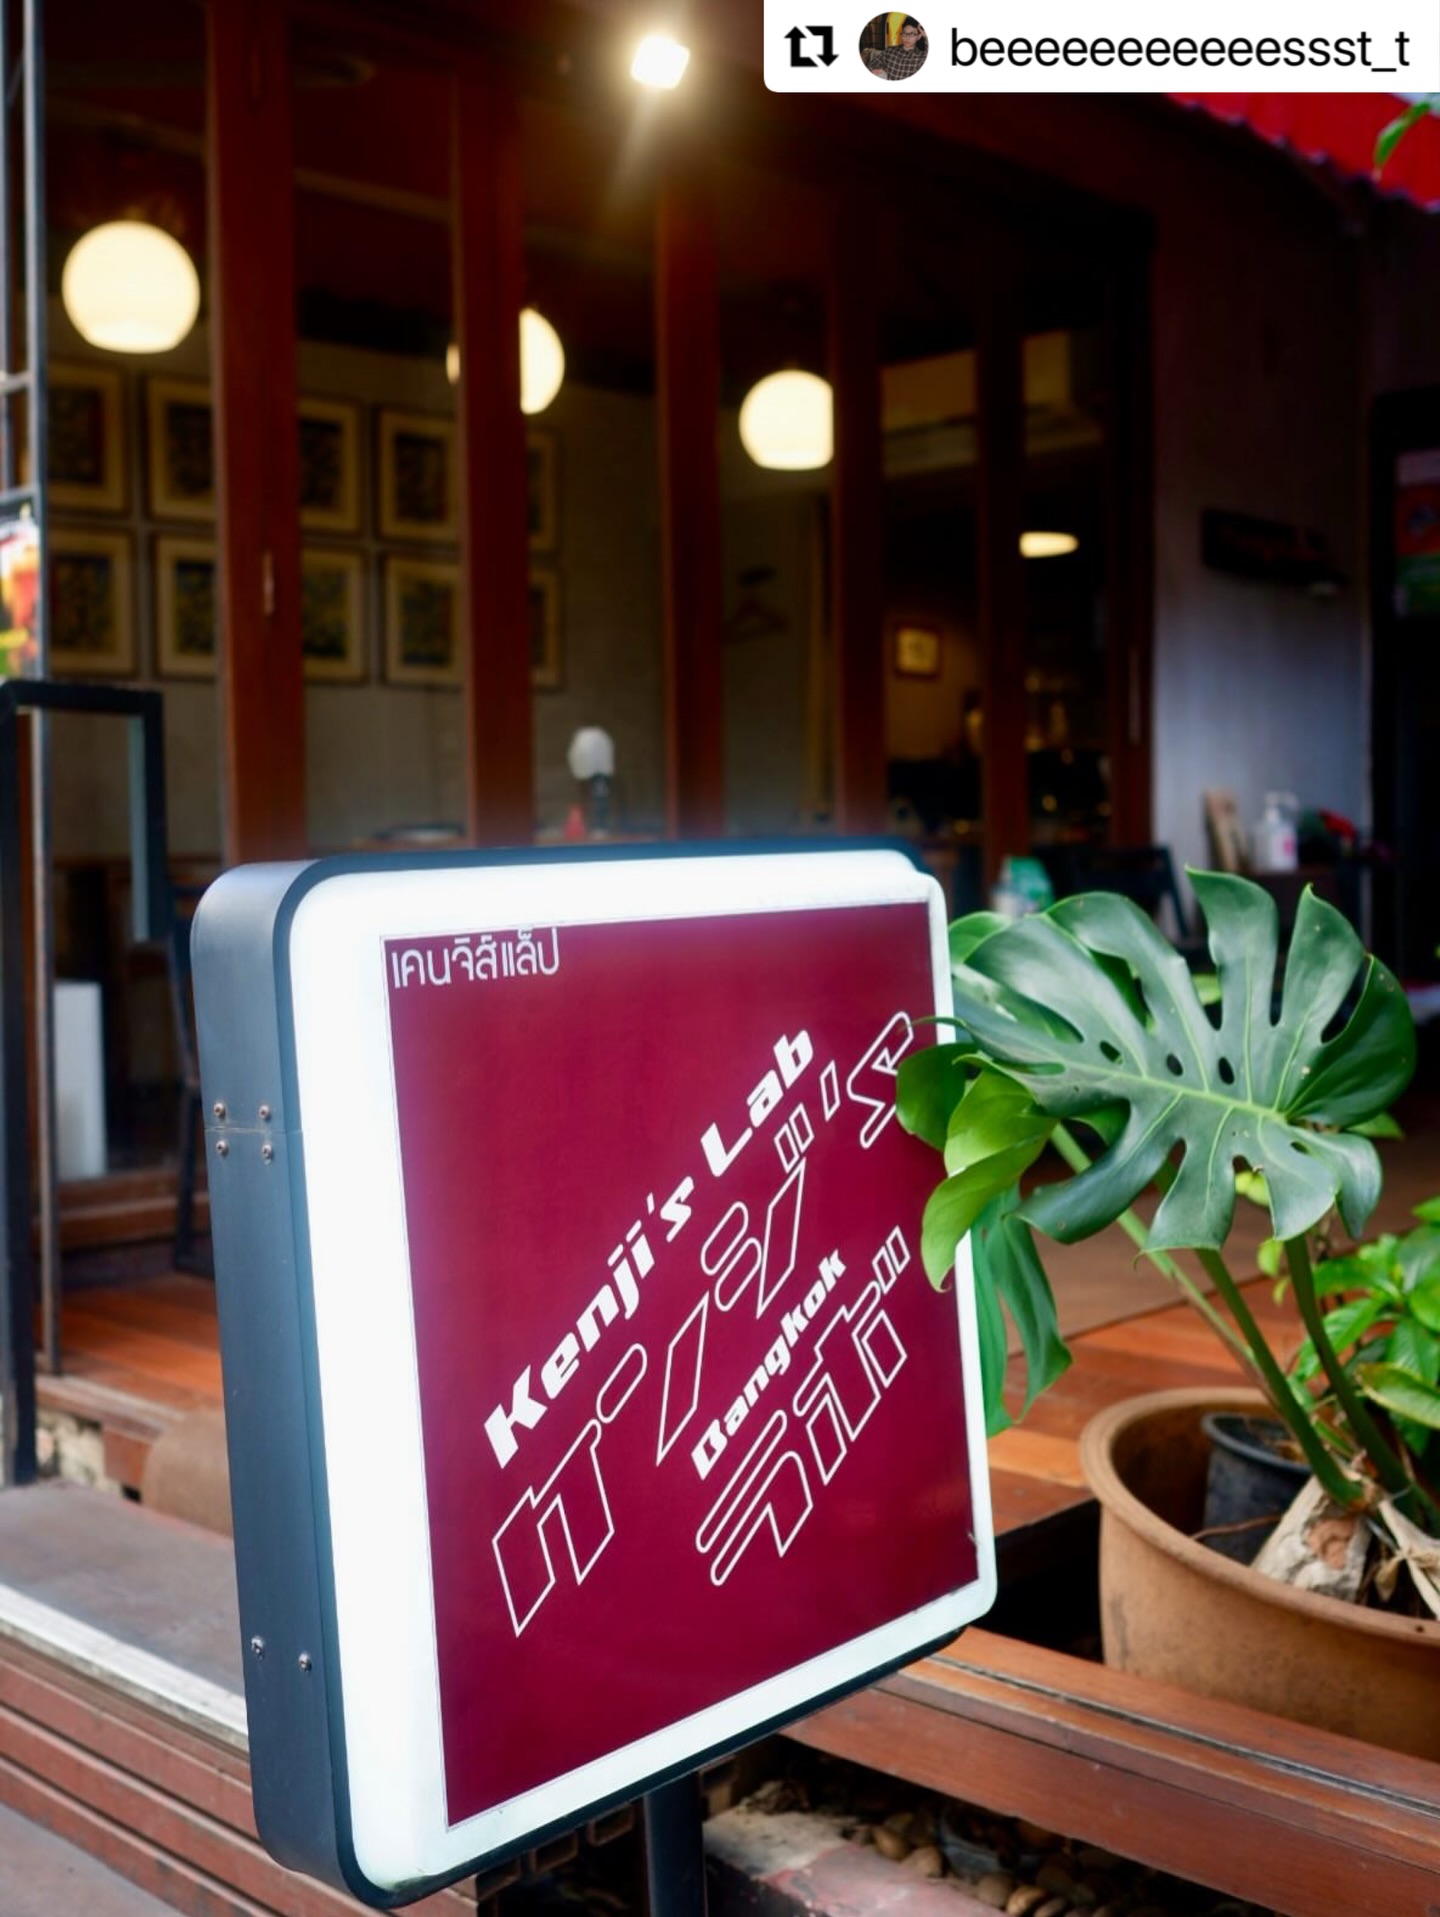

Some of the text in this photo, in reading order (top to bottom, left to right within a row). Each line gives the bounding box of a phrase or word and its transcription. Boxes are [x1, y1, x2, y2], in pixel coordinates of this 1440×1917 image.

[483, 1029, 814, 1469] Kenji's Lab
[690, 1249, 847, 1481] Bangkok
[695, 1225, 911, 1587] ラボ
